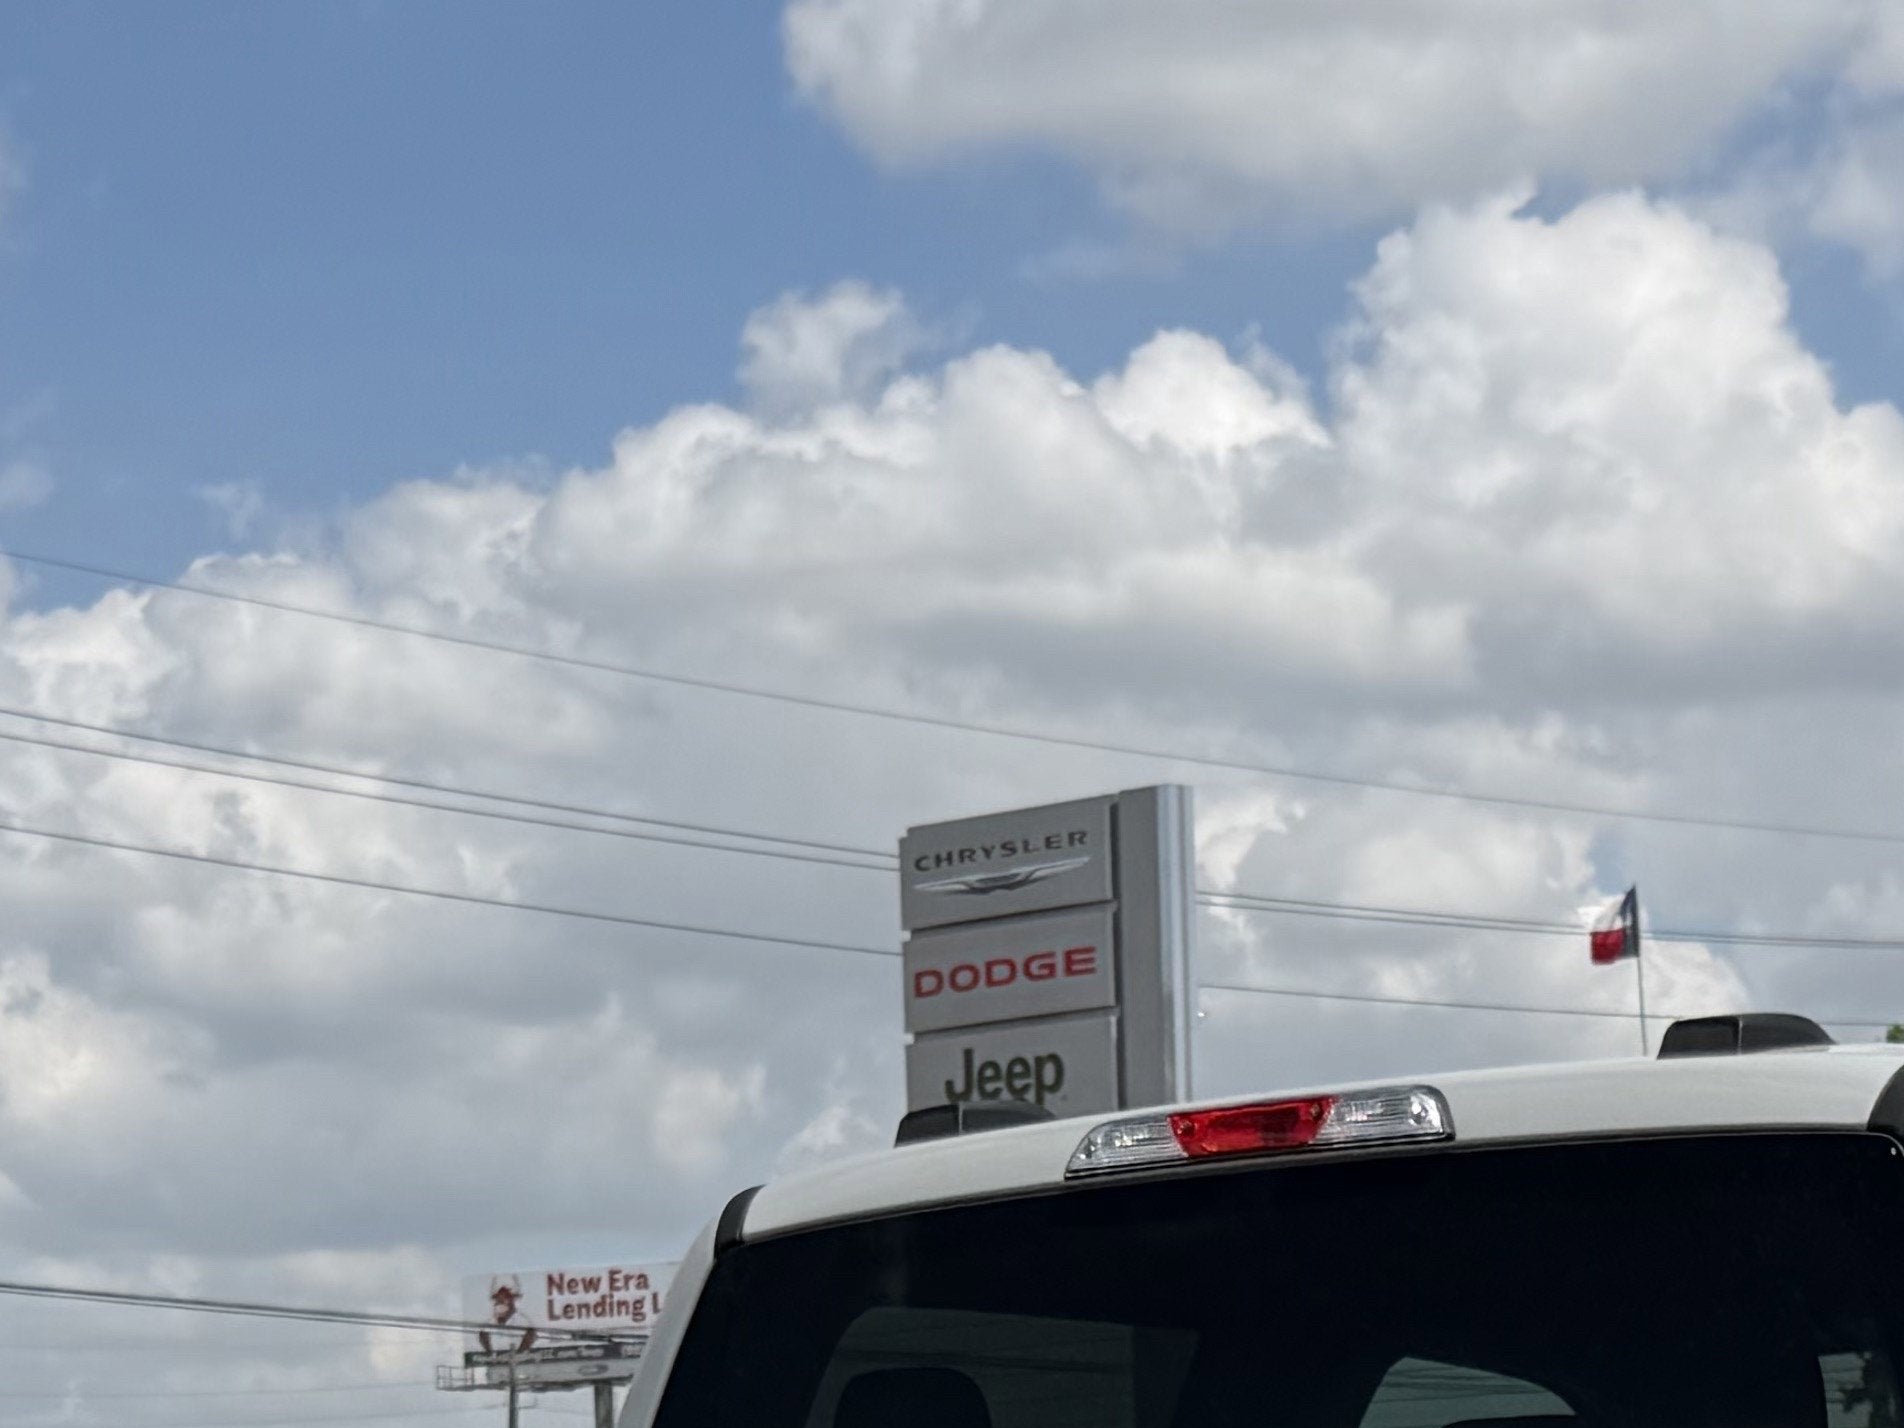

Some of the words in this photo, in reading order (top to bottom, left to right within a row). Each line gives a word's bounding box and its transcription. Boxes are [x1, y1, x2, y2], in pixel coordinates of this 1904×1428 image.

[914, 830, 1089, 872] CHRYSLER
[913, 946, 1097, 998] DODGE
[944, 1047, 1064, 1105] Jeep
[547, 1272, 602, 1296] New
[608, 1269, 649, 1292] Era
[547, 1293, 646, 1323] Lending
